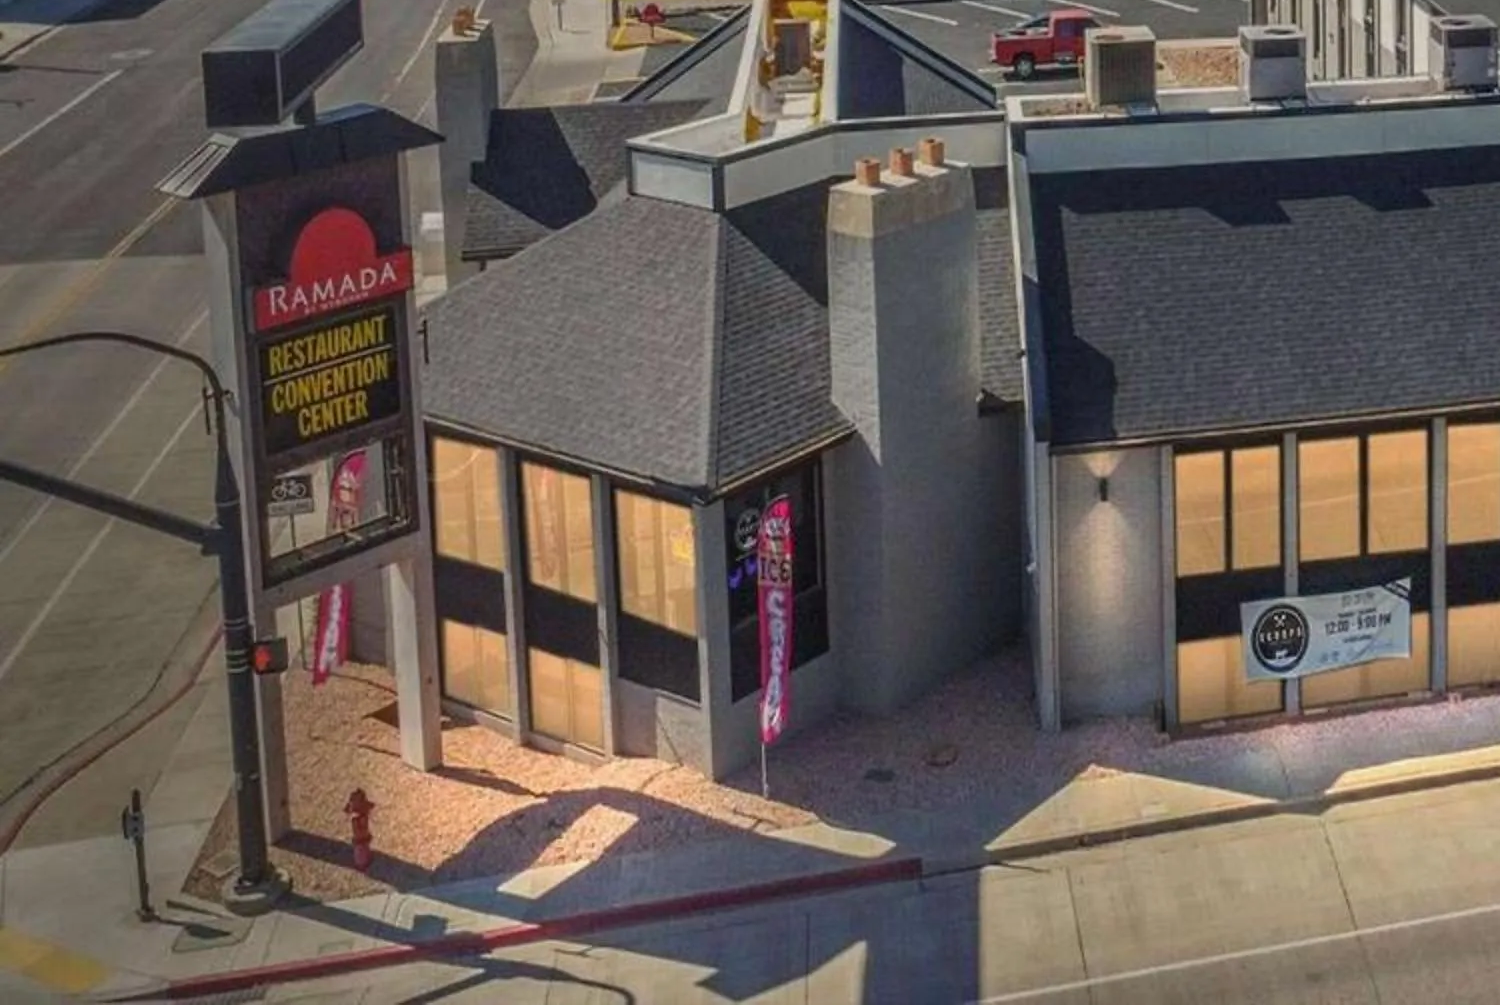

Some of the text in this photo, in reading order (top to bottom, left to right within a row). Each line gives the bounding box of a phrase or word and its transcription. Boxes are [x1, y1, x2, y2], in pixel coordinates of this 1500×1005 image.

[269, 262, 397, 315] RAMADA
[268, 315, 387, 376] RESTAURANT
[271, 351, 389, 413] CONVENTION
[298, 390, 368, 436] CENTER
